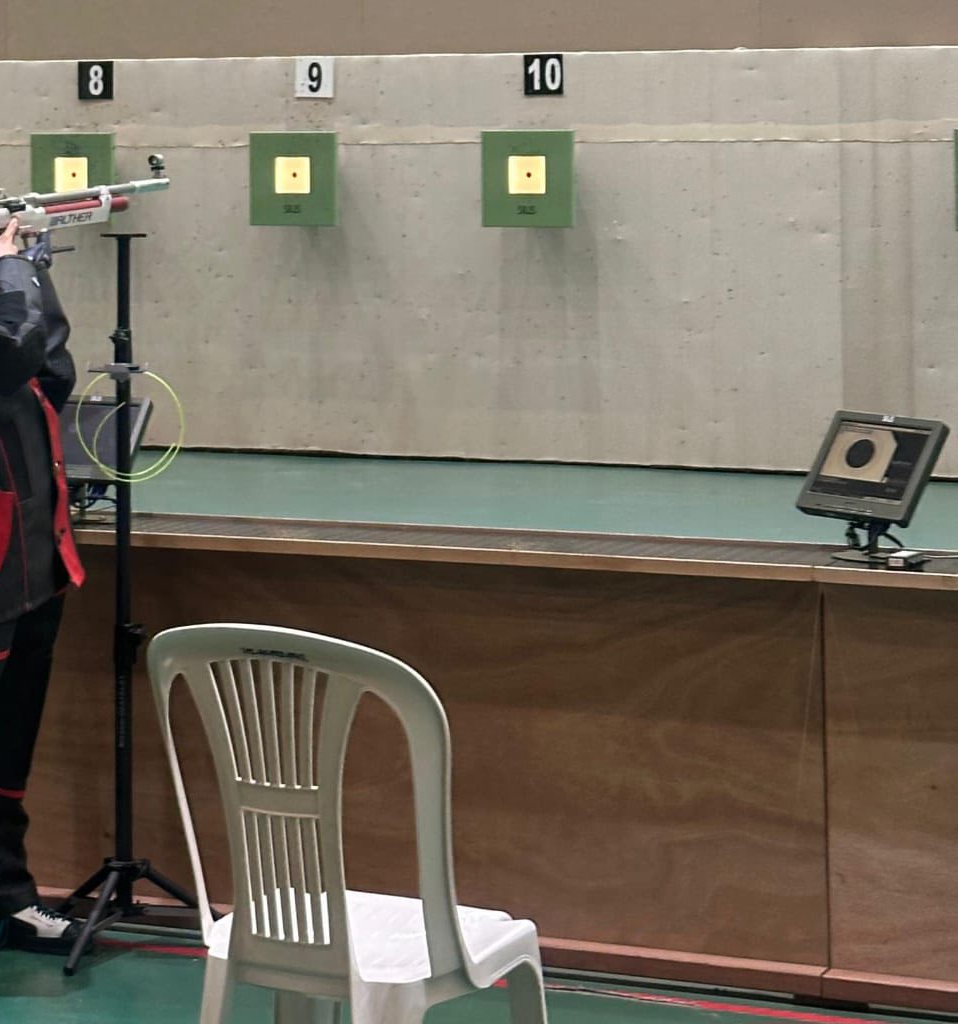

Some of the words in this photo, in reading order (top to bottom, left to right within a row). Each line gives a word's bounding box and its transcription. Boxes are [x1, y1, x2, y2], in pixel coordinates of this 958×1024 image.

[88, 65, 104, 96] 8
[308, 62, 322, 93] 9
[528, 58, 561, 91] 10
